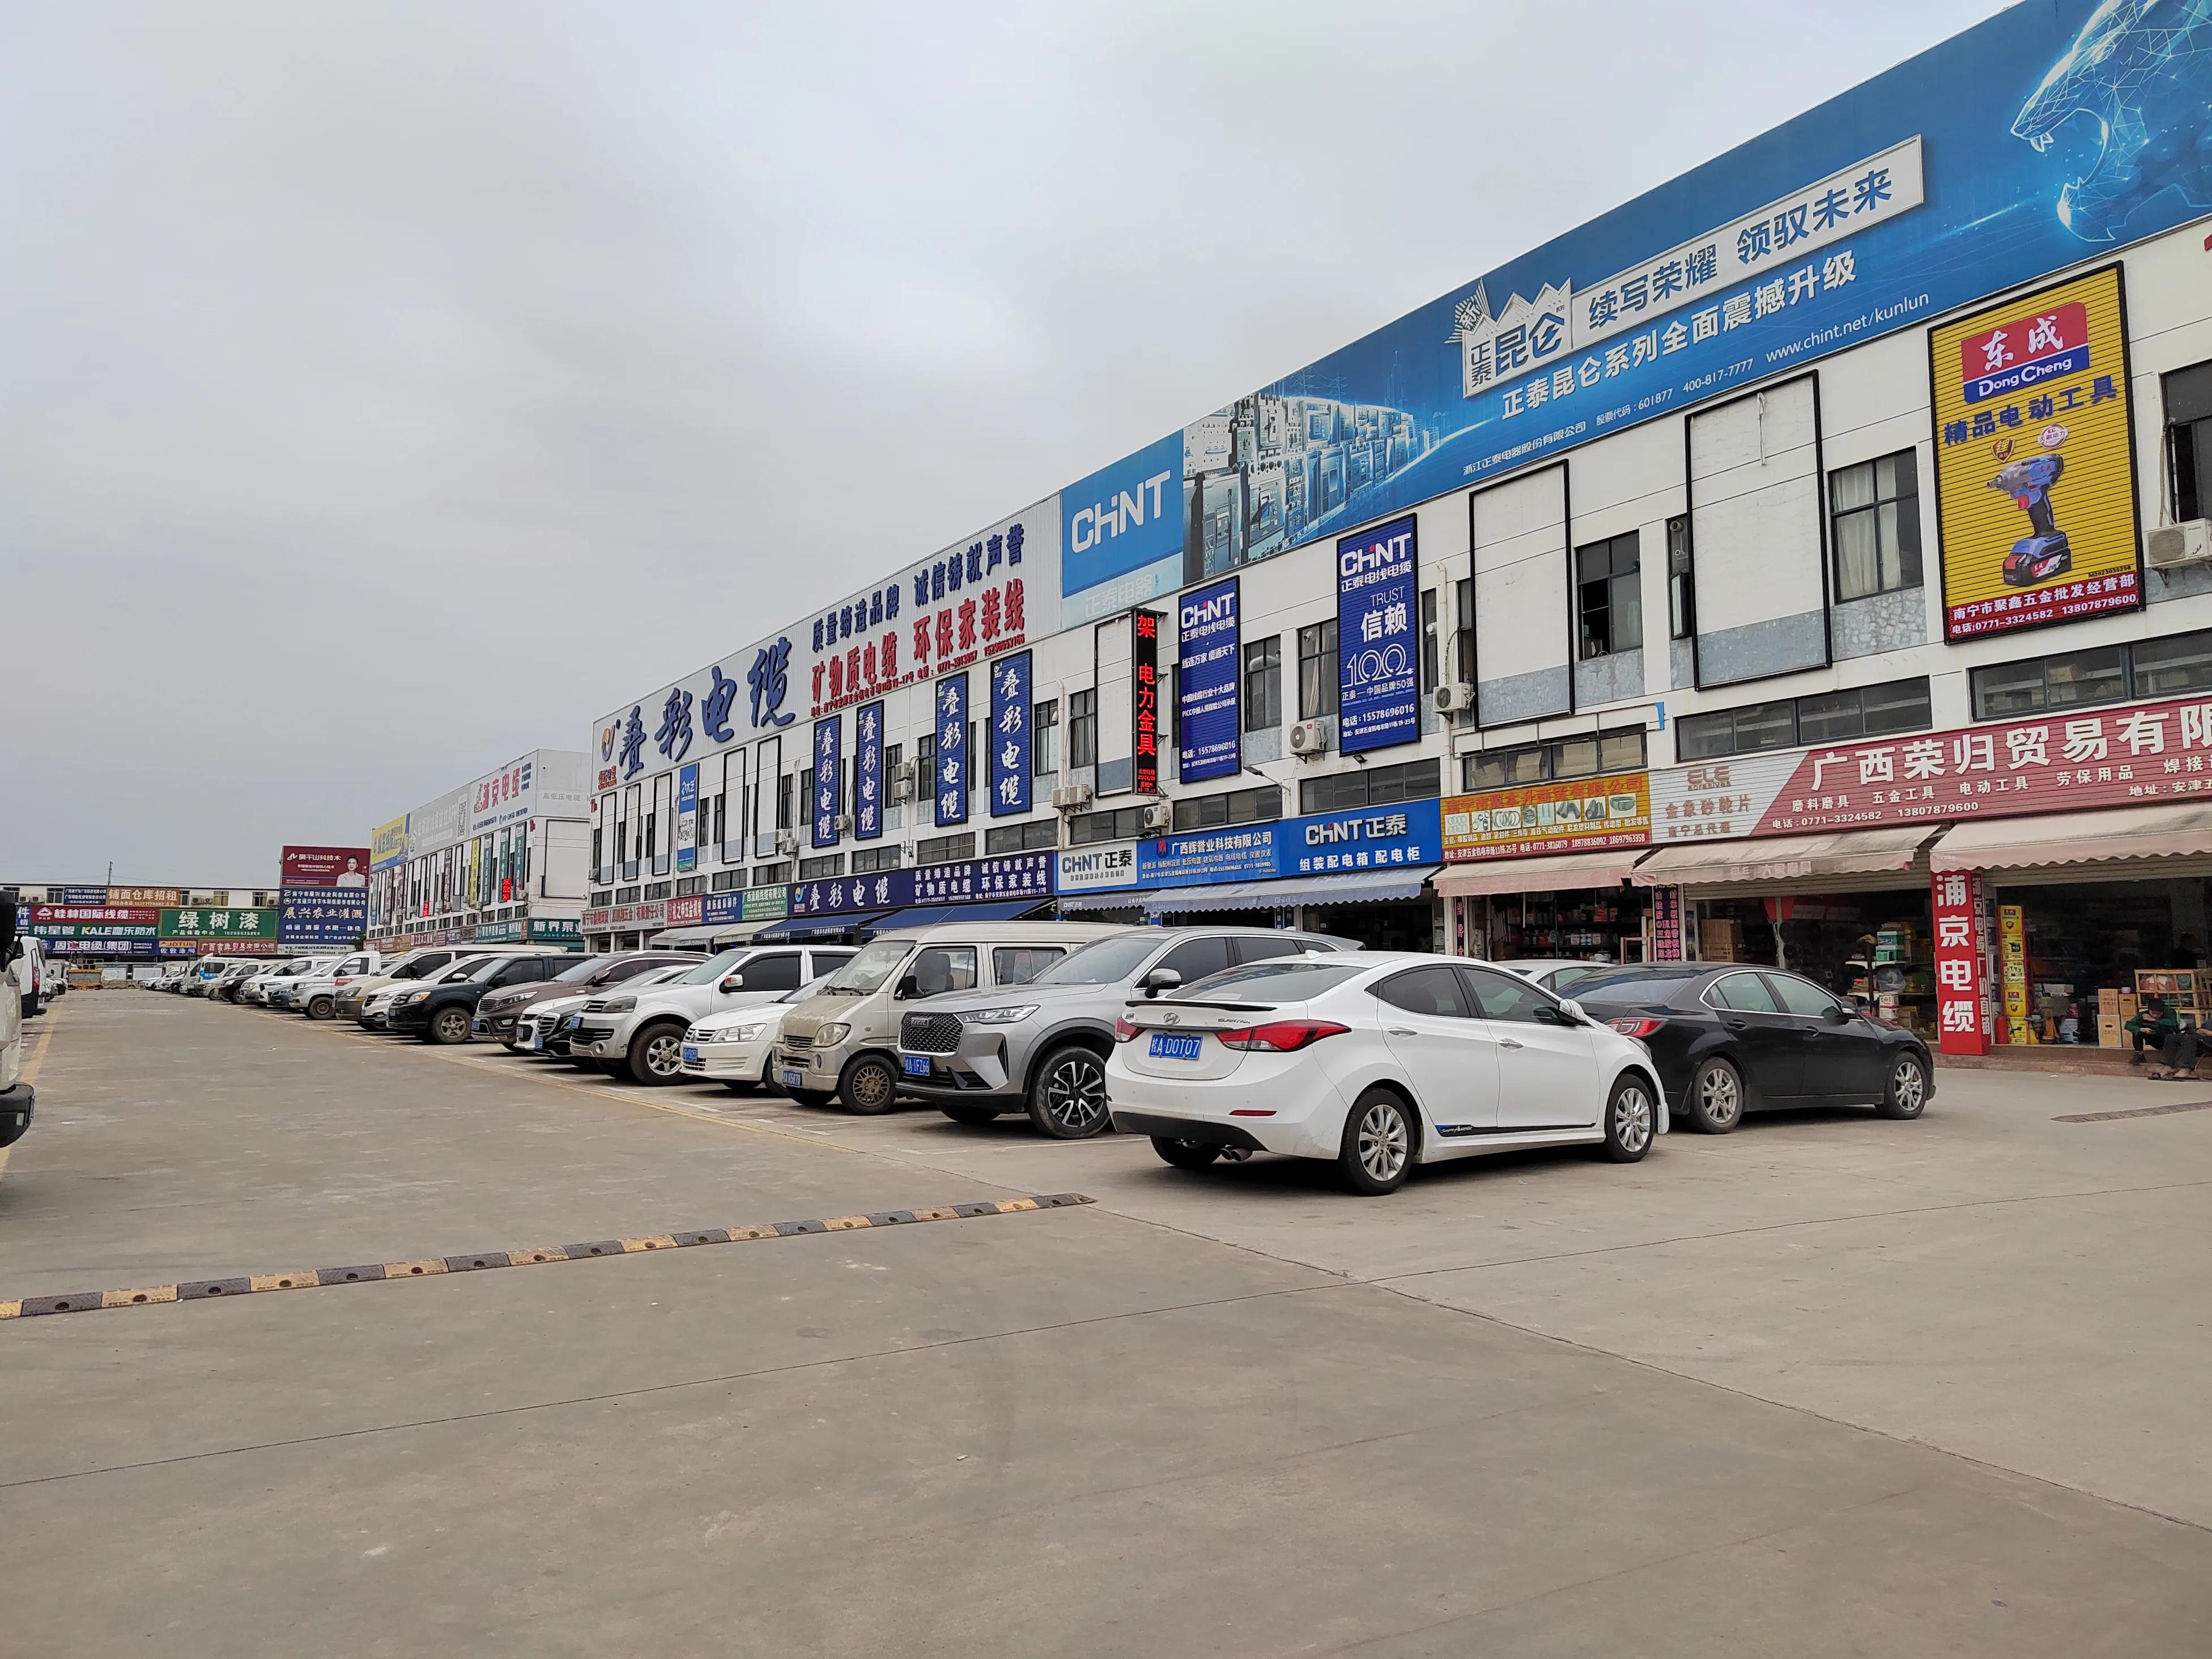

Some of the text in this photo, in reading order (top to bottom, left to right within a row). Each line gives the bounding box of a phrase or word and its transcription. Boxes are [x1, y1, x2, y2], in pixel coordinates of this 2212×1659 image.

[1589, 167, 1892, 331] 续写荣耀 领驭未来
[1495, 312, 1564, 377] 昆仑
[1501, 249, 1857, 420] 正泰昆仑系列全面震撼升级
[1980, 315, 2064, 371] 东成
[1463, 420, 1586, 476] 浙江正泰电器股份有限公司
[1683, 358, 1754, 393] 400-817-7777
[1766, 293, 1929, 363] www.chint.net/kunlun
[1944, 375, 2117, 445] 精品电动工具
[813, 523, 1024, 653] 质量缔造品牌 诚信铸就声誉
[1342, 560, 1411, 593] 正泰电线电缆
[1370, 585, 1405, 607] TRUST
[1953, 575, 2134, 620] 南宁市聚鑫五金批发经营部
[1138, 615, 1156, 639] 架
[1361, 602, 1407, 643] 信赖
[1952, 594, 2137, 633] 电话:0771-3324582 13807879600
[812, 578, 1024, 704] 矿物质电缆 环保家装线
[1181, 615, 1236, 643] 正泰电线电缆
[1138, 663, 1156, 756] 电力金具
[1198, 741, 1235, 755] 15578696016
[1687, 765, 1730, 784] ELE
[1792, 755, 2212, 813] 磨料磨具 五金工具 电动工具 劳保用品 焊接
[1366, 814, 1407, 839] 正泰
[1772, 811, 1882, 829] 电话:0771-3324582
[1898, 802, 1979, 817] 13807879600
[915, 856, 1046, 881] 质量缔造品牌 诚信铸就声誉
[1105, 849, 1132, 869] 正泰
[1300, 846, 1420, 871] 组装配电箱 配电柜
[109, 890, 177, 901] 铺面仓库招租
[915, 870, 1047, 896] 矿物质电缆 环保家装线
[54, 909, 129, 919] 桂林国际线缆
[178, 911, 259, 929] 绿树漆
[283, 907, 364, 920] 展兴农业灌溉
[33, 926, 74, 934] 伟星管
[1936, 875, 1975, 1032] 浦京电缆
